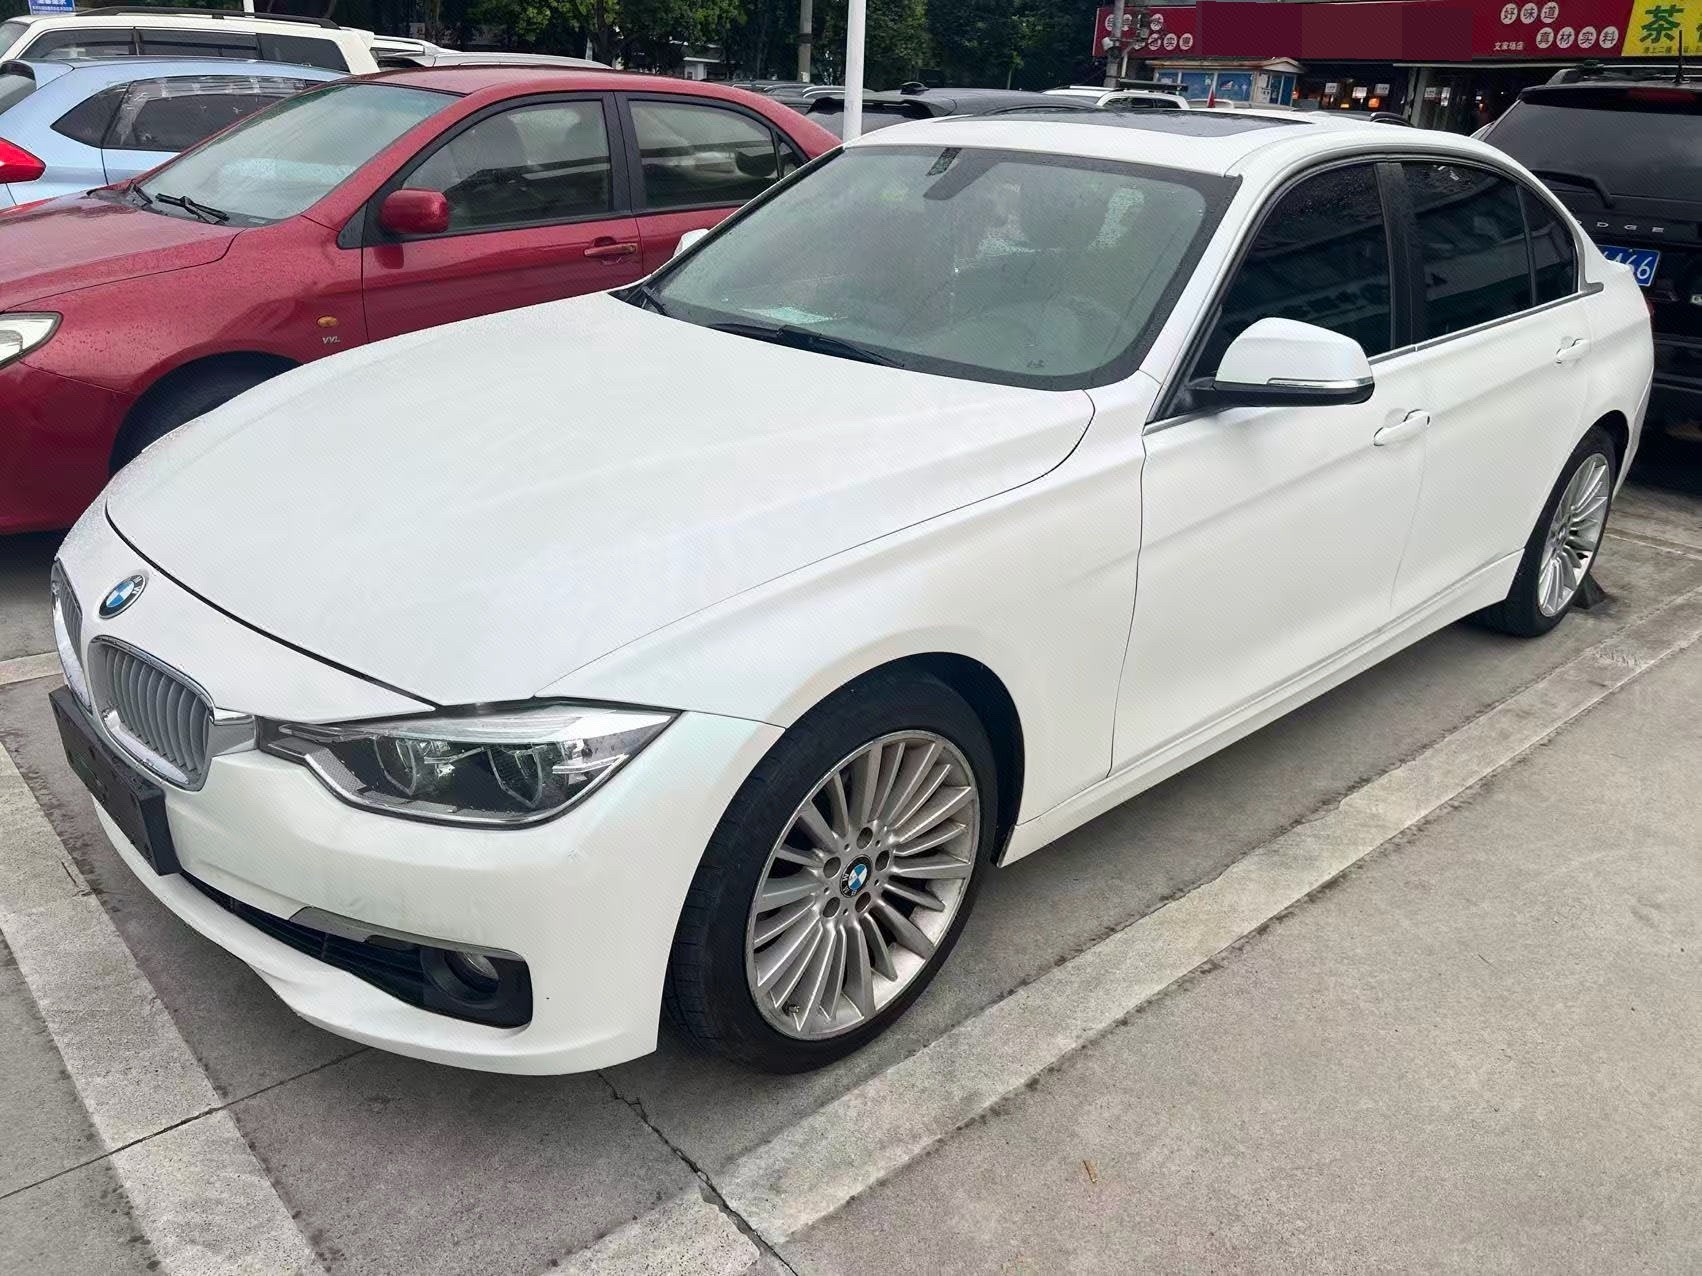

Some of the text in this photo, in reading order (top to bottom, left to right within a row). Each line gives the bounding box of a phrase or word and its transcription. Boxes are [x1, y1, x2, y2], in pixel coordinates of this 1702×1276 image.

[1502, 5, 1557, 21] 好味道
[1639, 4, 1702, 44] 茶
[1537, 30, 1616, 46] 真材实料
